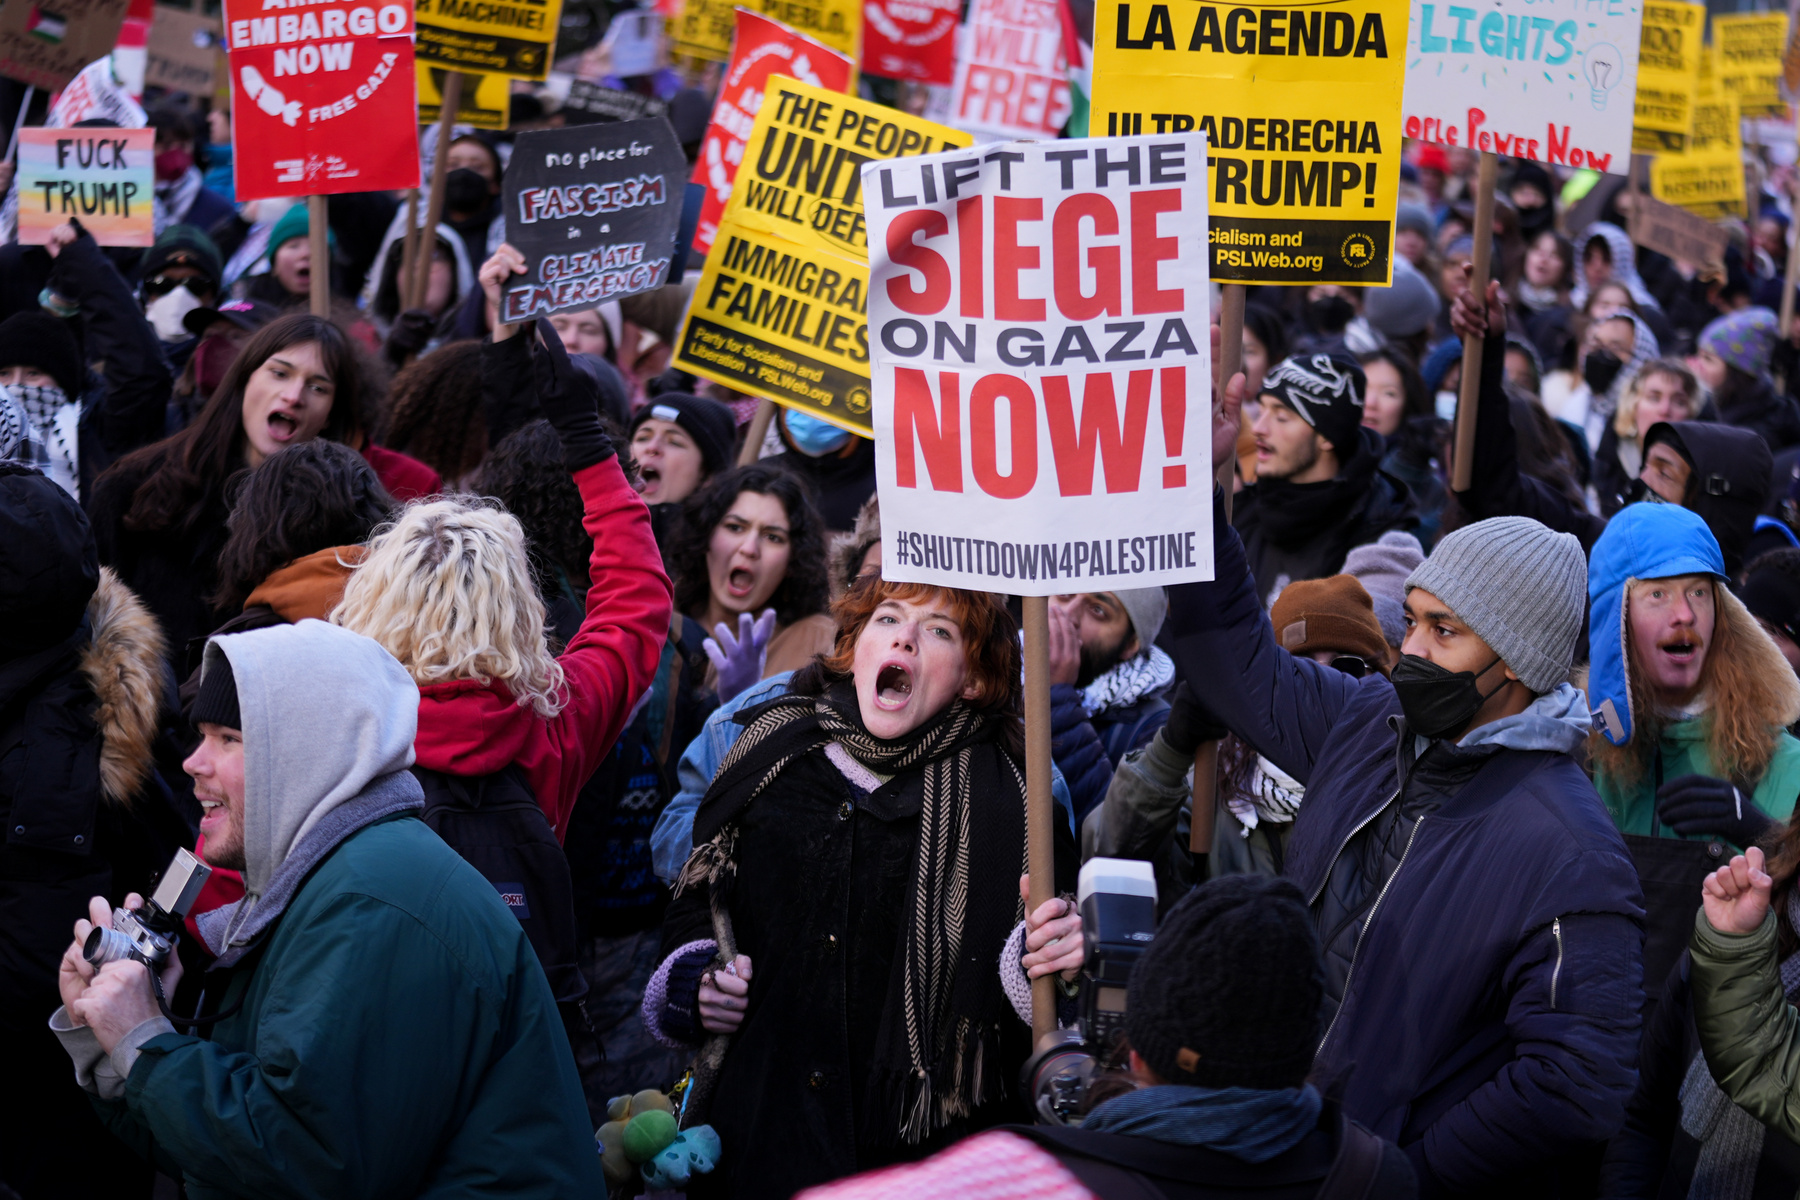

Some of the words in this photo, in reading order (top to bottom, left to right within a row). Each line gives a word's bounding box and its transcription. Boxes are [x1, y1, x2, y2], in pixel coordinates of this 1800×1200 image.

[231, 4, 407, 49] EMBARGO
[437, 0, 546, 31] MACHINE!
[1115, 3, 1176, 51] LA
[1188, 6, 1388, 59] AGENDA
[1420, 3, 1578, 66] LIGHTS
[273, 41, 355, 78] NOW
[308, 94, 358, 124] FREE
[355, 52, 399, 101] GAZA
[958, 63, 1069, 138] FREE
[776, 89, 833, 136] THE
[836, 108, 961, 158] PEOPL
[56, 138, 129, 170] FUCK
[545, 153, 574, 168] no
[578, 147, 627, 169] place
[628, 140, 653, 157] for
[879, 151, 1025, 209] LIFT
[1045, 143, 1187, 190] THE
[34, 180, 138, 218] TRUMP
[518, 173, 667, 225] FASCISM
[745, 179, 804, 226] WILL
[811, 201, 869, 247] DEF
[567, 225, 581, 239] in
[599, 223, 610, 234] a
[885, 187, 1185, 322] SIEGE
[1269, 230, 1303, 247] and
[1350, 243, 1366, 257] PSL
[539, 242, 646, 283] CLIMATE
[721, 236, 868, 316] IMMIGRA
[1216, 251, 1324, 272] PSLWeb.org
[504, 257, 670, 322] EMERGENCY
[705, 272, 870, 365] FAMILIES
[880, 318, 977, 364] ON
[996, 318, 1199, 367] GAZA
[689, 342, 746, 373] Liberation
[757, 366, 834, 407] PSLWeb.org
[695, 327, 726, 349] Party
[726, 336, 744, 352] for
[743, 343, 798, 374] Socialism
[797, 365, 825, 383] and
[893, 365, 1187, 500] NOW!
[896, 530, 1197, 581] #SHUTITDOWN4PALESTINE
